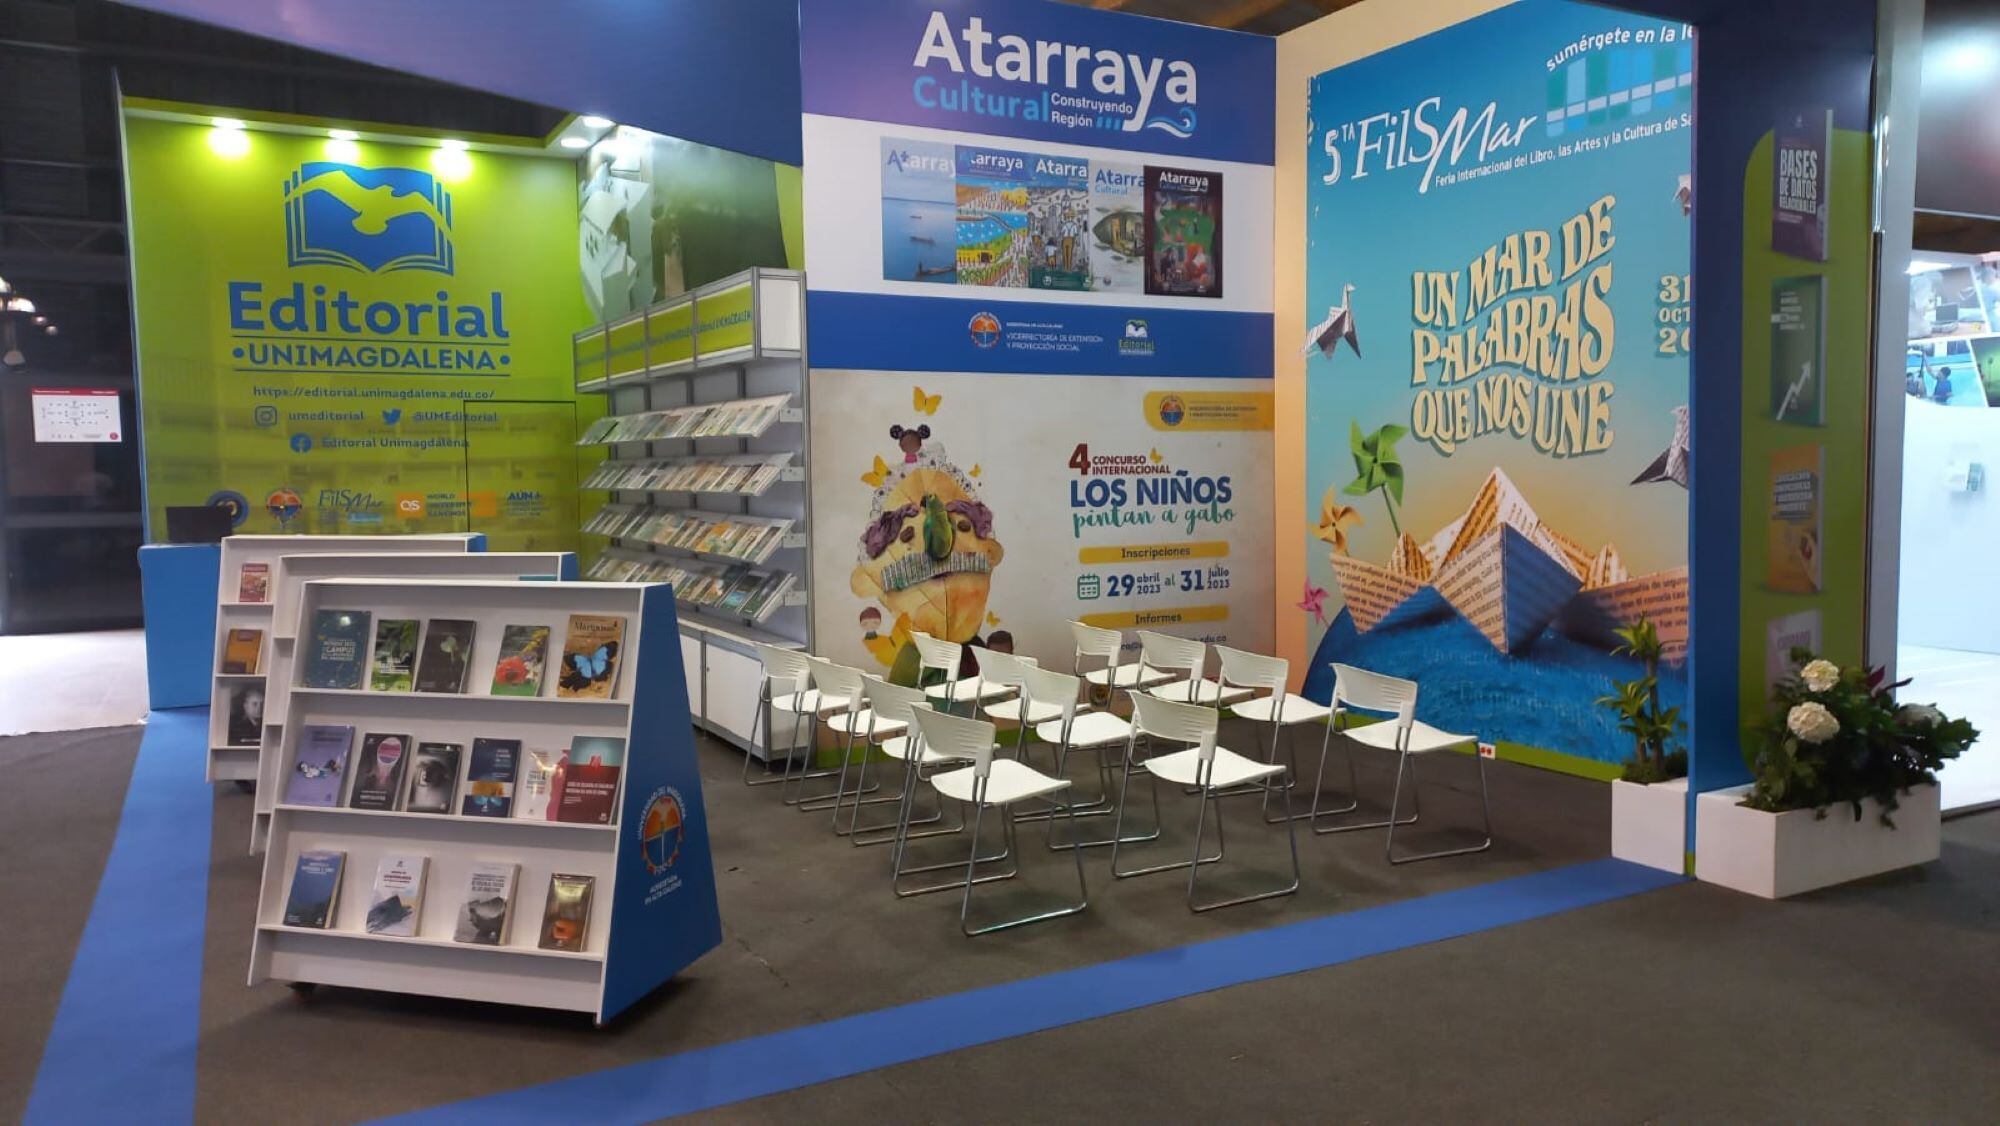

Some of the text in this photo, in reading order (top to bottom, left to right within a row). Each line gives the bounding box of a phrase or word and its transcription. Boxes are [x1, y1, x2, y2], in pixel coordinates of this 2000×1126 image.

[1546, 26, 1631, 72] sumérgete
[1635, 29, 1655, 43] en
[1660, 25, 1676, 43] la
[912, 10, 1197, 132] Atarraya
[913, 75, 1049, 123] Cultural
[1051, 92, 1133, 115] Construyendo
[1051, 110, 1093, 128] Región
[1435, 171, 1456, 188] Feria
[1457, 159, 1512, 182] Internacional
[1514, 154, 1528, 168] del
[1558, 143, 1572, 157] las
[1574, 136, 1601, 152] Artes
[1603, 134, 1610, 148] y
[1612, 131, 1621, 144] la
[1623, 119, 1662, 141] Cultura
[1664, 116, 1678, 130] de
[1780, 148, 1818, 179] BASES
[1159, 171, 1209, 192] Atarraya
[1779, 176, 1817, 200] DE DATOS
[1411, 195, 1616, 327] UN MAR DE
[228, 281, 510, 339] Editorial
[1411, 261, 1616, 385] PALABRAS
[288, 411, 364, 421] umeditorial
[1412, 373, 1616, 458] QUE NOS UNE
[322, 437, 469, 451] Editorial Unimagdalena
[1069, 443, 1147, 476] 4 CONCURSO
[1092, 464, 1171, 476] INTERNACIONAL
[1070, 470, 1232, 508] LOS NIÑOS
[1073, 499, 1238, 539] pintan a gabo
[1121, 547, 1191, 560] Inscripciones
[1106, 566, 1230, 597] 29 abril al 31 julio
[1137, 579, 1230, 595] 2023 2023
[1135, 613, 1182, 625] Informes
